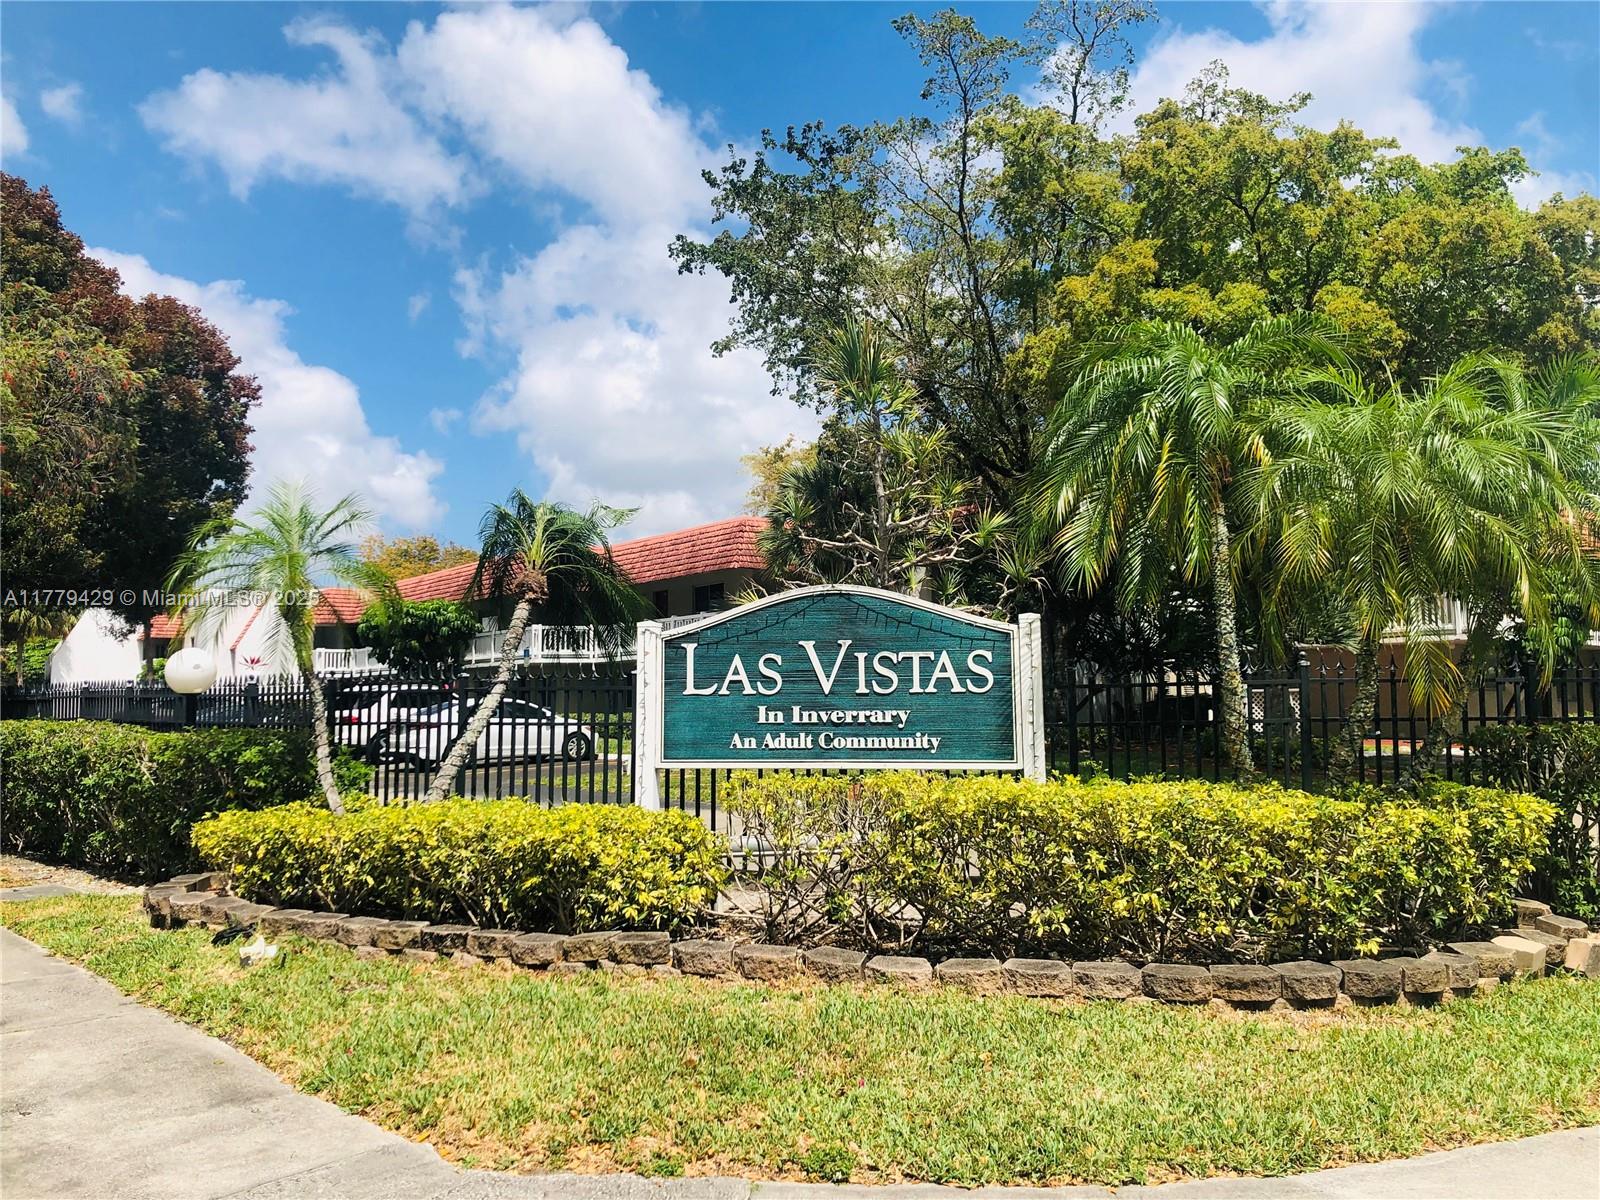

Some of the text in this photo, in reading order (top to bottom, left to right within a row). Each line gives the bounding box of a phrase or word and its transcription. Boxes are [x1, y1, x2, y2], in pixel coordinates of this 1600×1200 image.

[681, 639, 996, 697] LAS VISTAS
[757, 705, 912, 729] In Inverrary
[729, 731, 942, 753] An Adult Community
